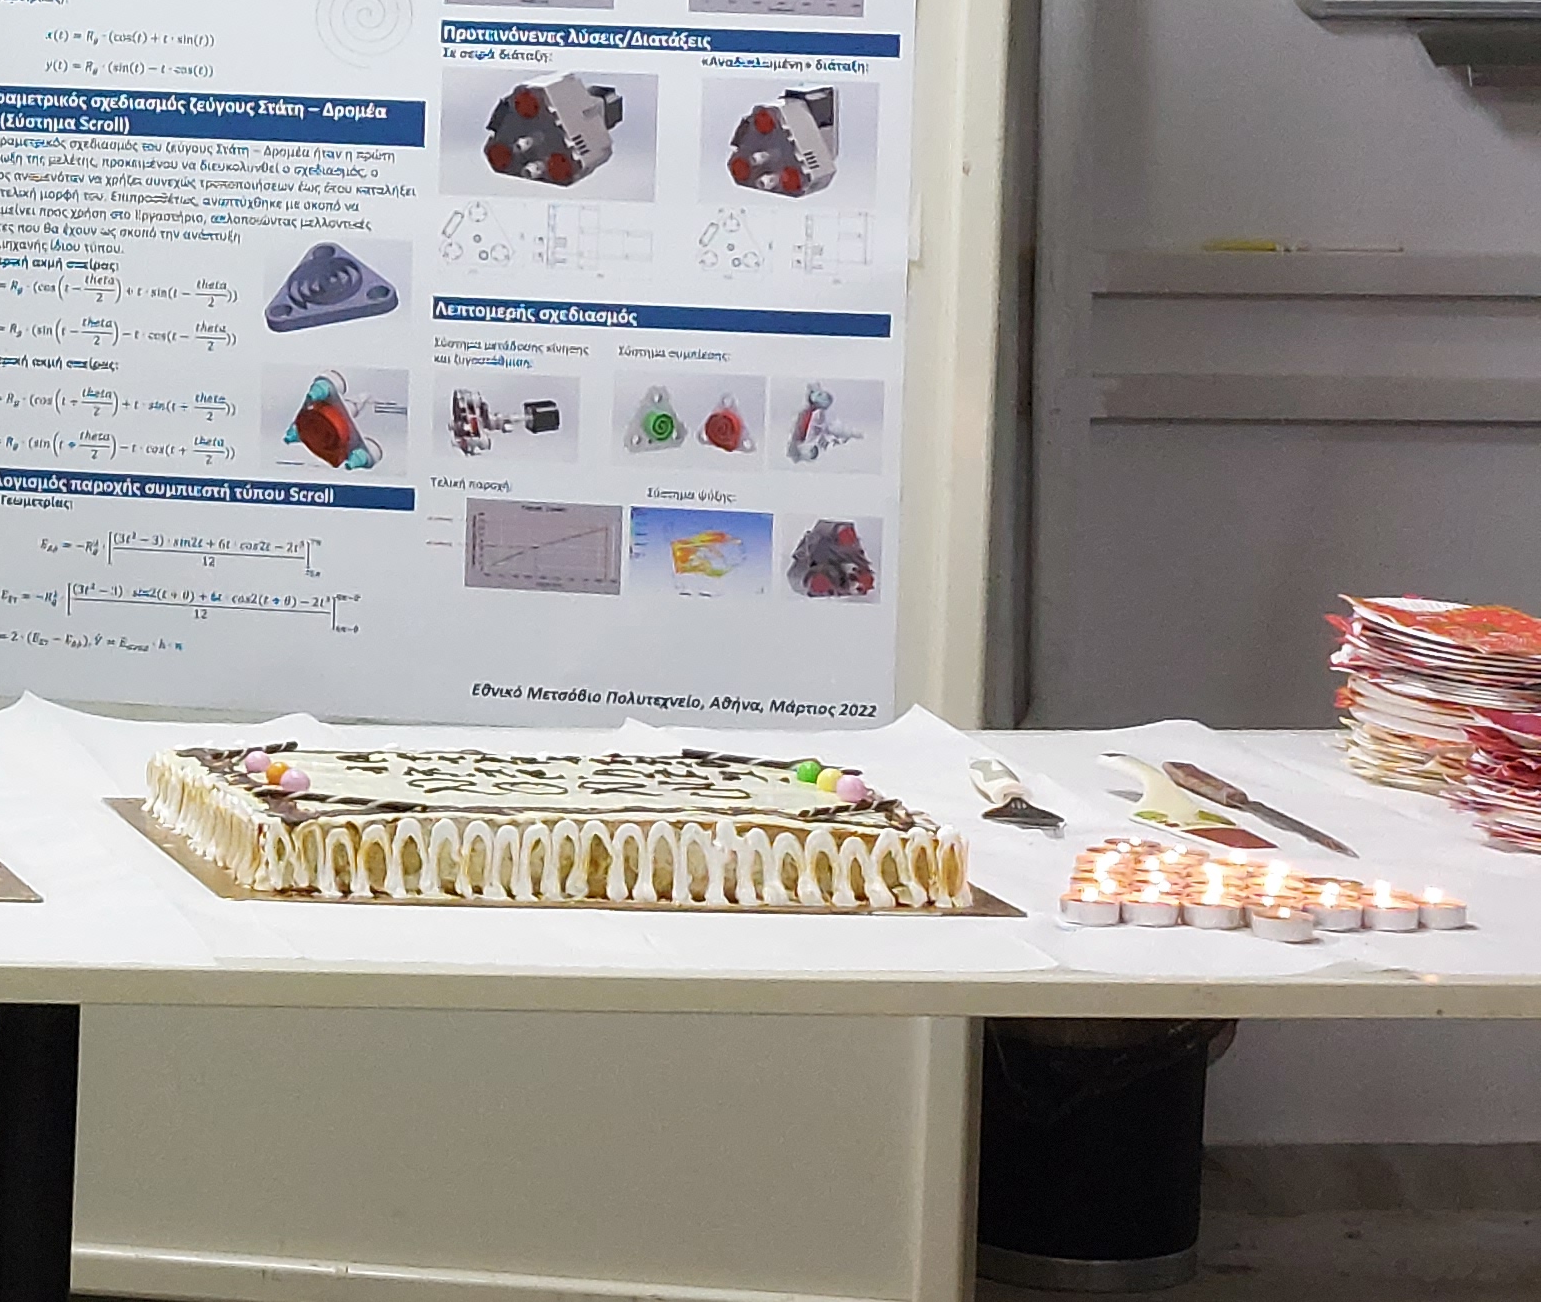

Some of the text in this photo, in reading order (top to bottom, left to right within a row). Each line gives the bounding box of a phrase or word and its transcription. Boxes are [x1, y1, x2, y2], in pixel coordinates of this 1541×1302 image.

[90, 93, 187, 115] σχεδιασμός
[189, 96, 256, 117] ζεύγους
[257, 98, 305, 120] Στάτη
[322, 101, 388, 122] Δρομέα
[0, 112, 130, 135] (Σύστημα Scroll)
[434, 301, 638, 327] Λεπτομερής σχεδιασμός
[68, 478, 143, 500] παροχής
[141, 482, 232, 504] συμπιεστή
[231, 484, 286, 507] τύπου
[285, 487, 335, 509] Scroll
[471, 682, 877, 723] Εθνικό Μετσόβιο Πολυτεχνείο, Αθήνα, Μάρτιος 2022
